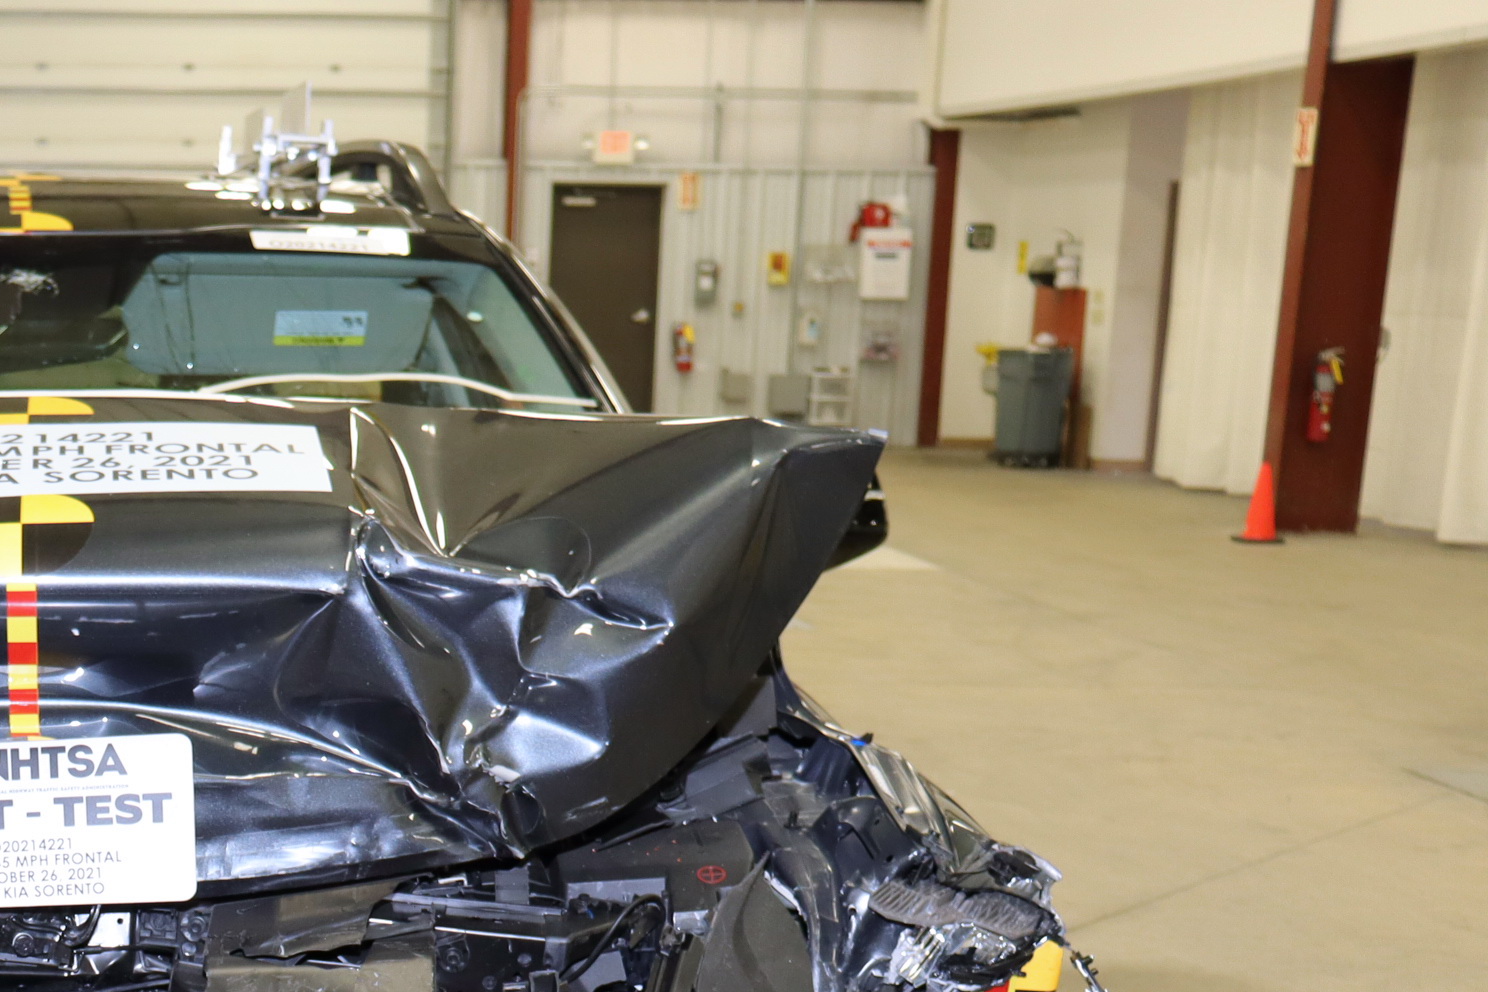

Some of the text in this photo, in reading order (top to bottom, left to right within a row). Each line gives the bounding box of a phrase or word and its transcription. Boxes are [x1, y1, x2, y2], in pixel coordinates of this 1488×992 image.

[105, 442, 306, 455] FRONTAL
[71, 456, 134, 469] 26,
[153, 454, 253, 467] 2021
[43, 467, 259, 484] SORENTO
[53, 792, 173, 827] TEST
[15, 854, 49, 868] MPH
[55, 851, 123, 865] FRONTAL
[41, 869, 63, 883] 26,
[68, 867, 102, 881] 2021
[4, 886, 29, 899] KIA
[35, 882, 105, 897] SORENTO
